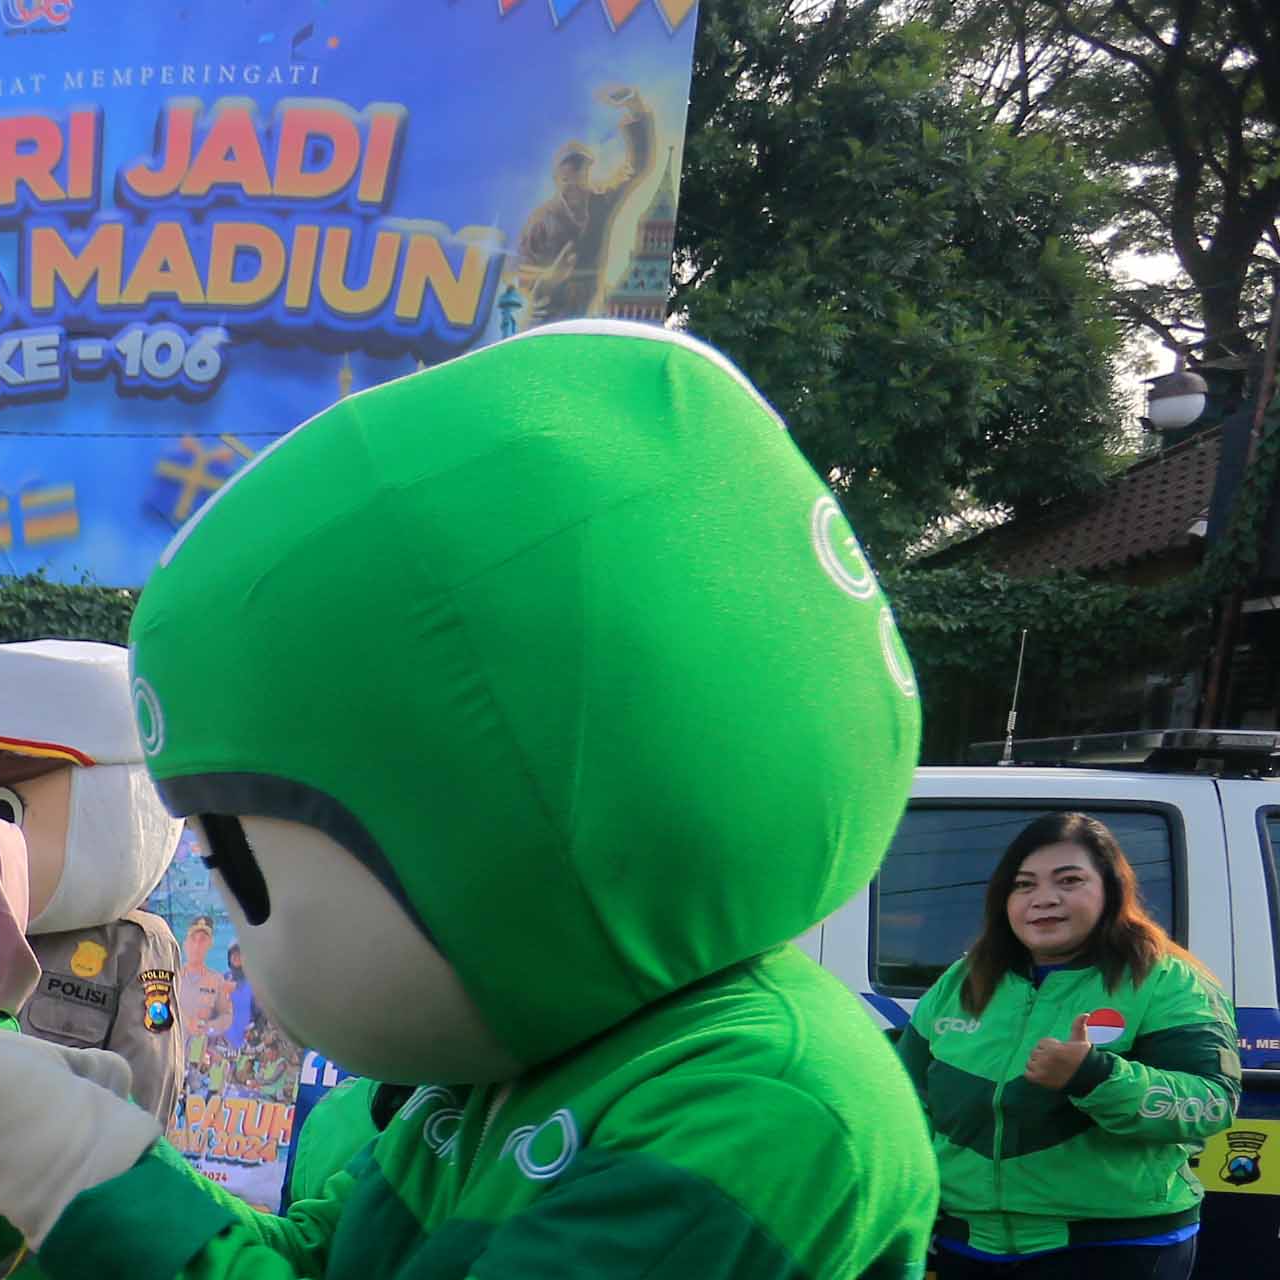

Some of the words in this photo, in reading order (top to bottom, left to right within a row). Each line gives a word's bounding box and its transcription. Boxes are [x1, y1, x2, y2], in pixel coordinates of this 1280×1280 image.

[63, 64, 322, 90] MEMPERINGATI
[124, 106, 399, 204] JADI
[31, 222, 484, 327] MADIUN
[115, 328, 226, 383] 106
[46, 977, 109, 1007] POLISI
[140, 969, 172, 982] POLDA
[184, 1094, 296, 1147] PATUH
[1139, 1085, 1230, 1123] Grab
[211, 1134, 278, 1164] 2024
